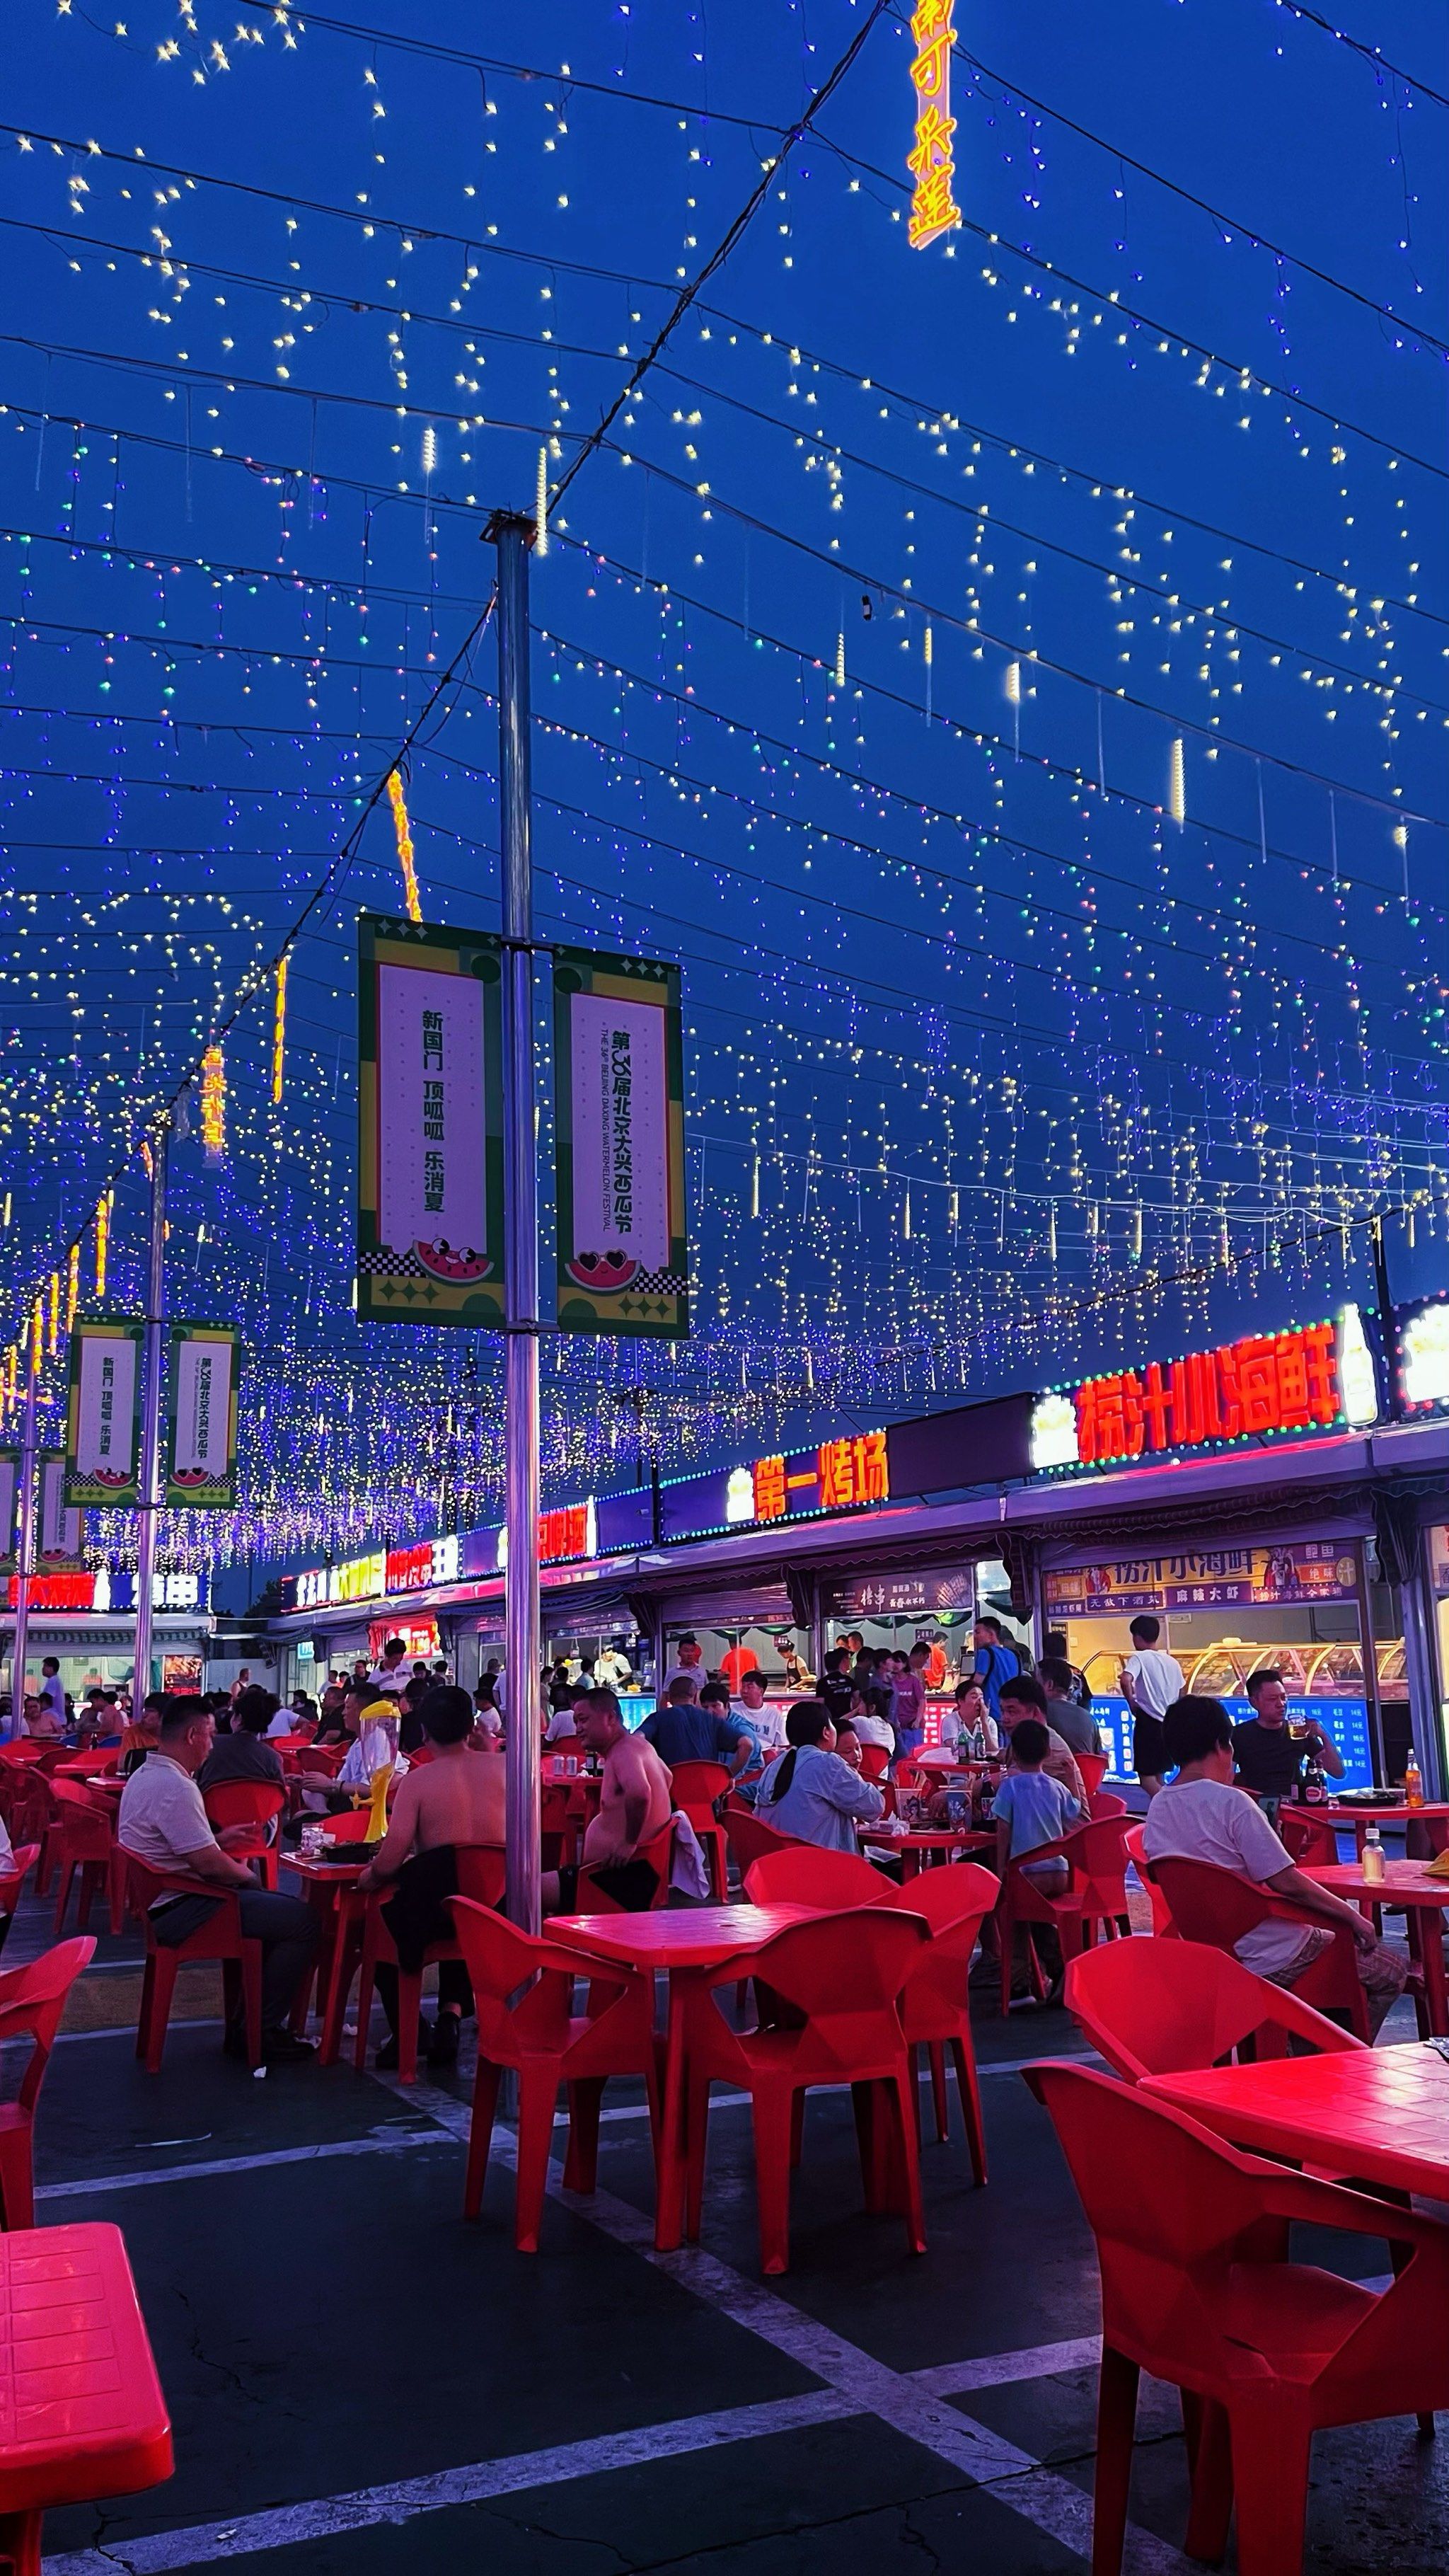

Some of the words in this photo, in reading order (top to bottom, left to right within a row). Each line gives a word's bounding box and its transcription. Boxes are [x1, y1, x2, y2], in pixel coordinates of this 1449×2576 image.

[422, 1009, 444, 1071] 新国门
[422, 1080, 446, 1142] 顶呱呱
[601, 1064, 610, 1096] BEIJING
[602, 1132, 611, 1192] WATERMELON
[611, 1029, 633, 1235] 第36届北京大兴西瓜节
[424, 1150, 446, 1213] 乐消夏
[603, 1193, 611, 1232] FESTIVAL
[1078, 1322, 1341, 1464] 捞汁小海鲜
[754, 1432, 890, 1522] 第一烤场
[1090, 1594, 1160, 1609] 无敌下酒菜
[1177, 1585, 1239, 1603] 麻辣大虾
